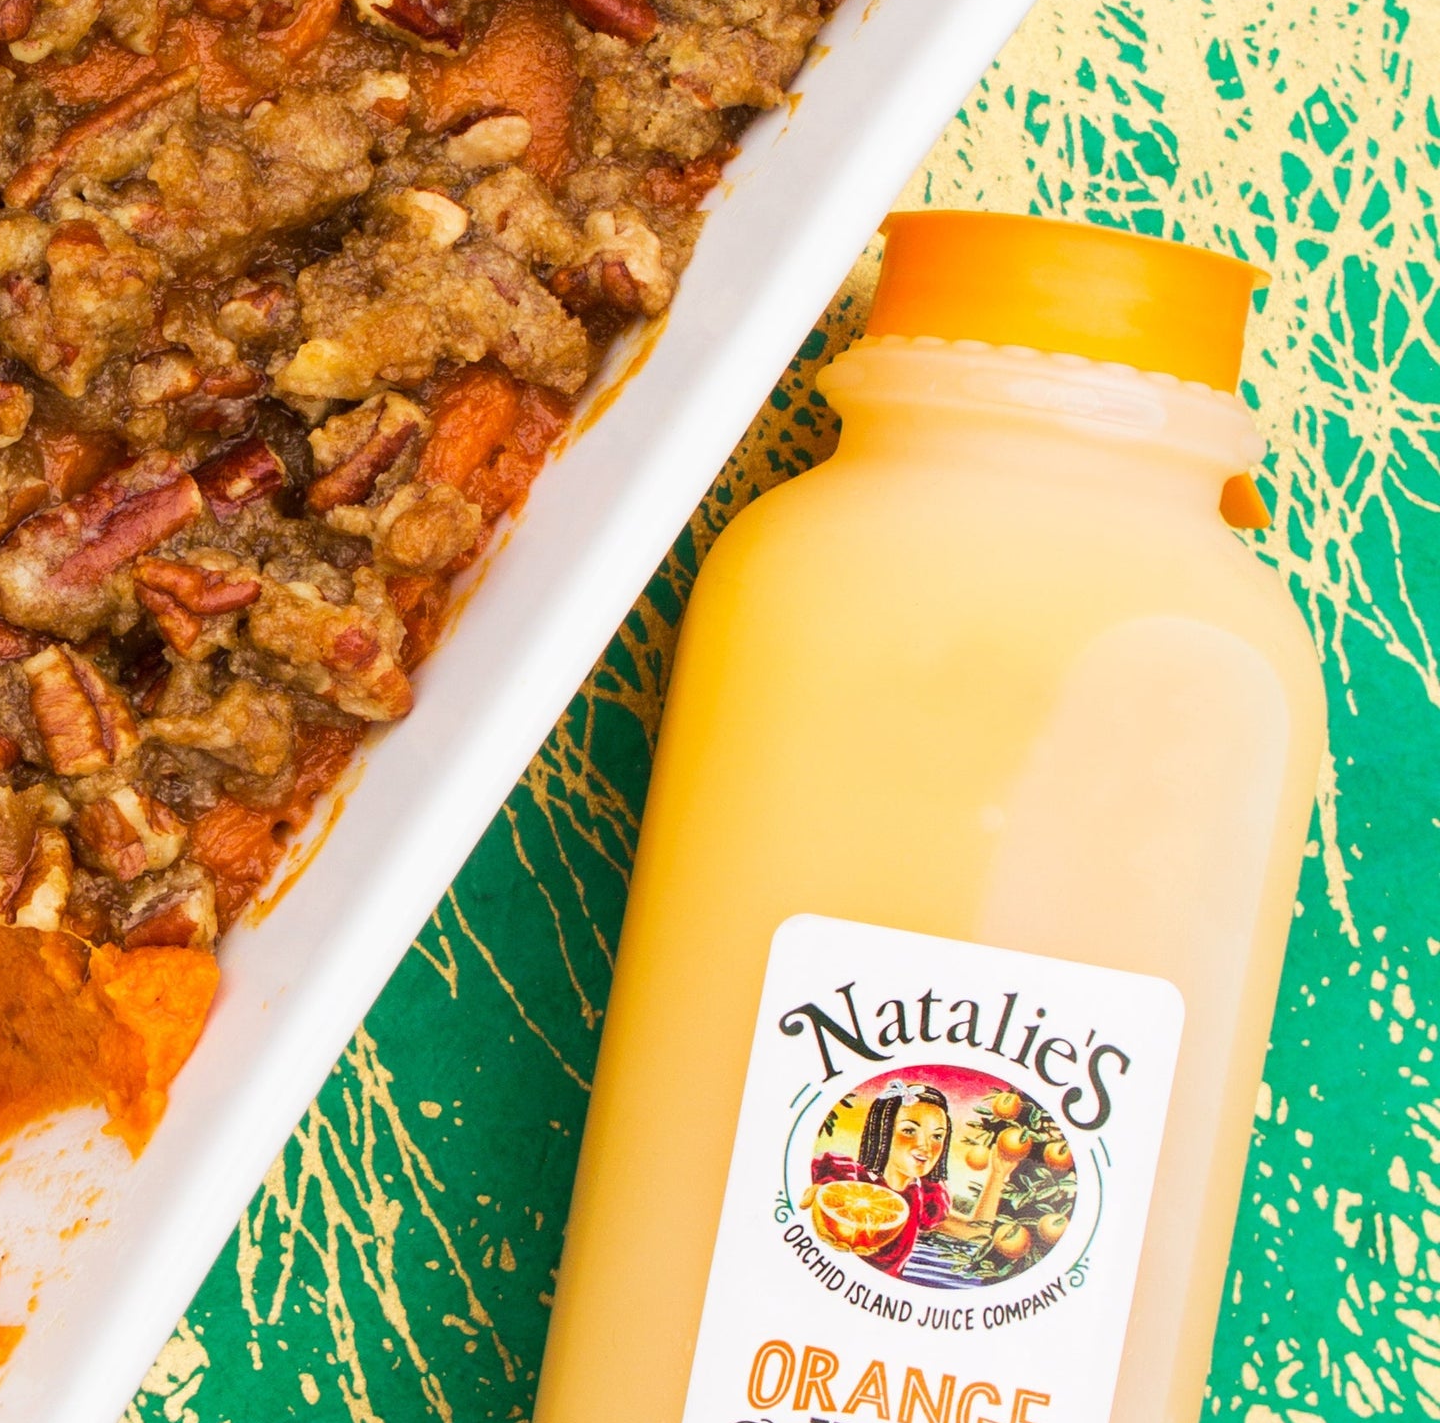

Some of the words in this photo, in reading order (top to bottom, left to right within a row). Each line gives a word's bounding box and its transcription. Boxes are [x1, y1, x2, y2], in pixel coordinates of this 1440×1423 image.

[783, 1223, 846, 1291] ORCHID
[844, 1281, 913, 1323] ISLAND
[917, 1306, 975, 1331] JUICE
[982, 1276, 1068, 1330] COMPANY
